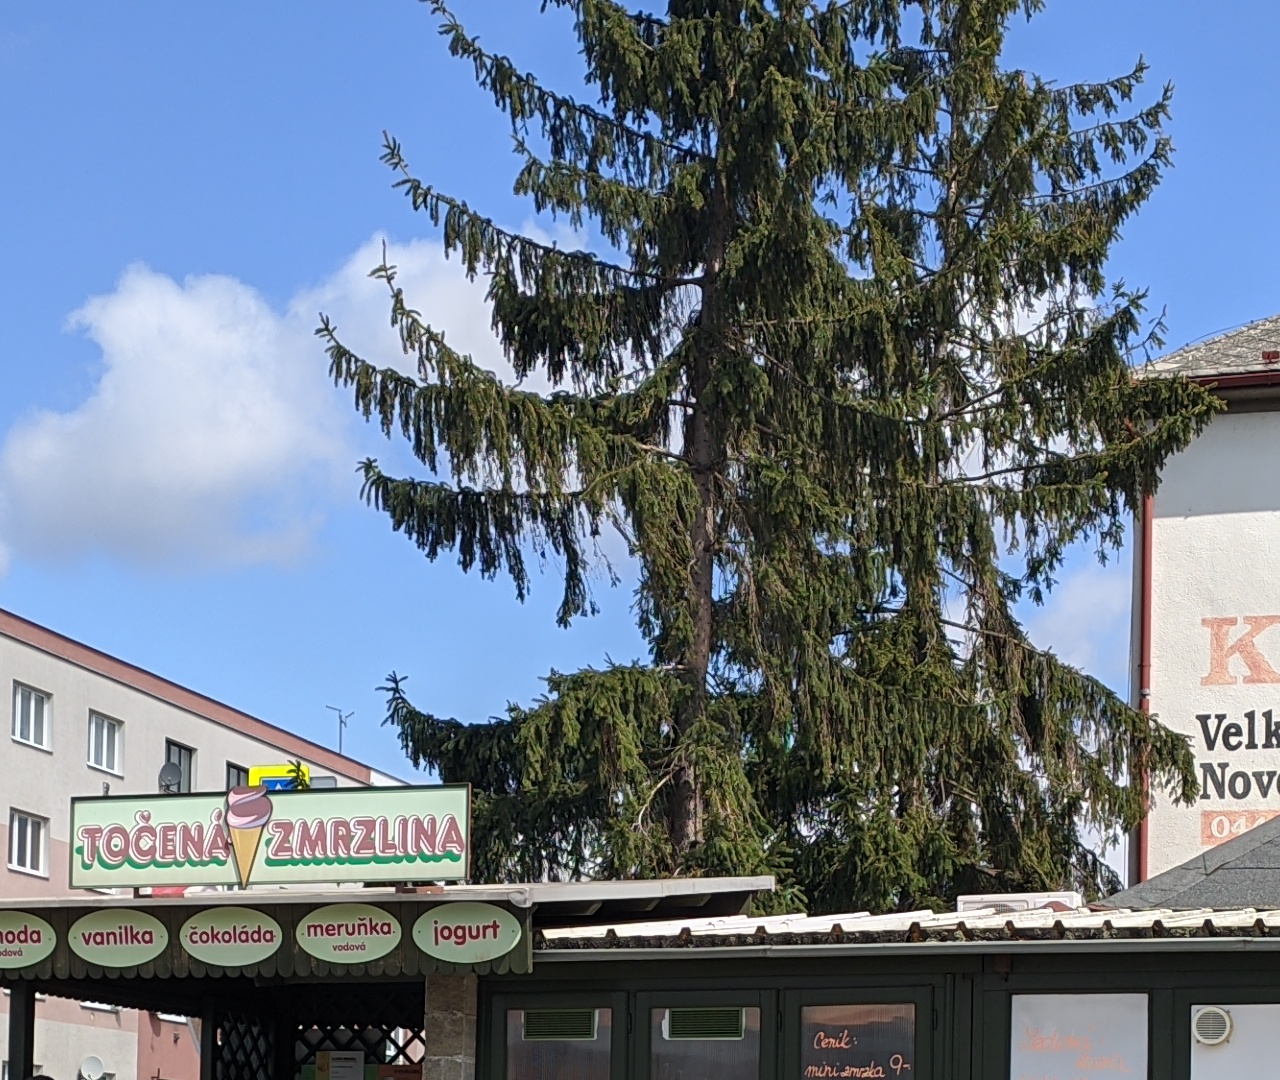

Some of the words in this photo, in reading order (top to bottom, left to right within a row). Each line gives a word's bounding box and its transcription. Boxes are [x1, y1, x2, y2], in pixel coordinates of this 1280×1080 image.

[77, 808, 231, 866] TOČENÁ
[267, 813, 465, 862] ZMRZLINA
[81, 925, 154, 946] vanilka
[189, 924, 275, 945] čokoláda
[306, 916, 393, 938] meruňka
[433, 919, 501, 946] jogurt
[332, 941, 367, 952] vodová
